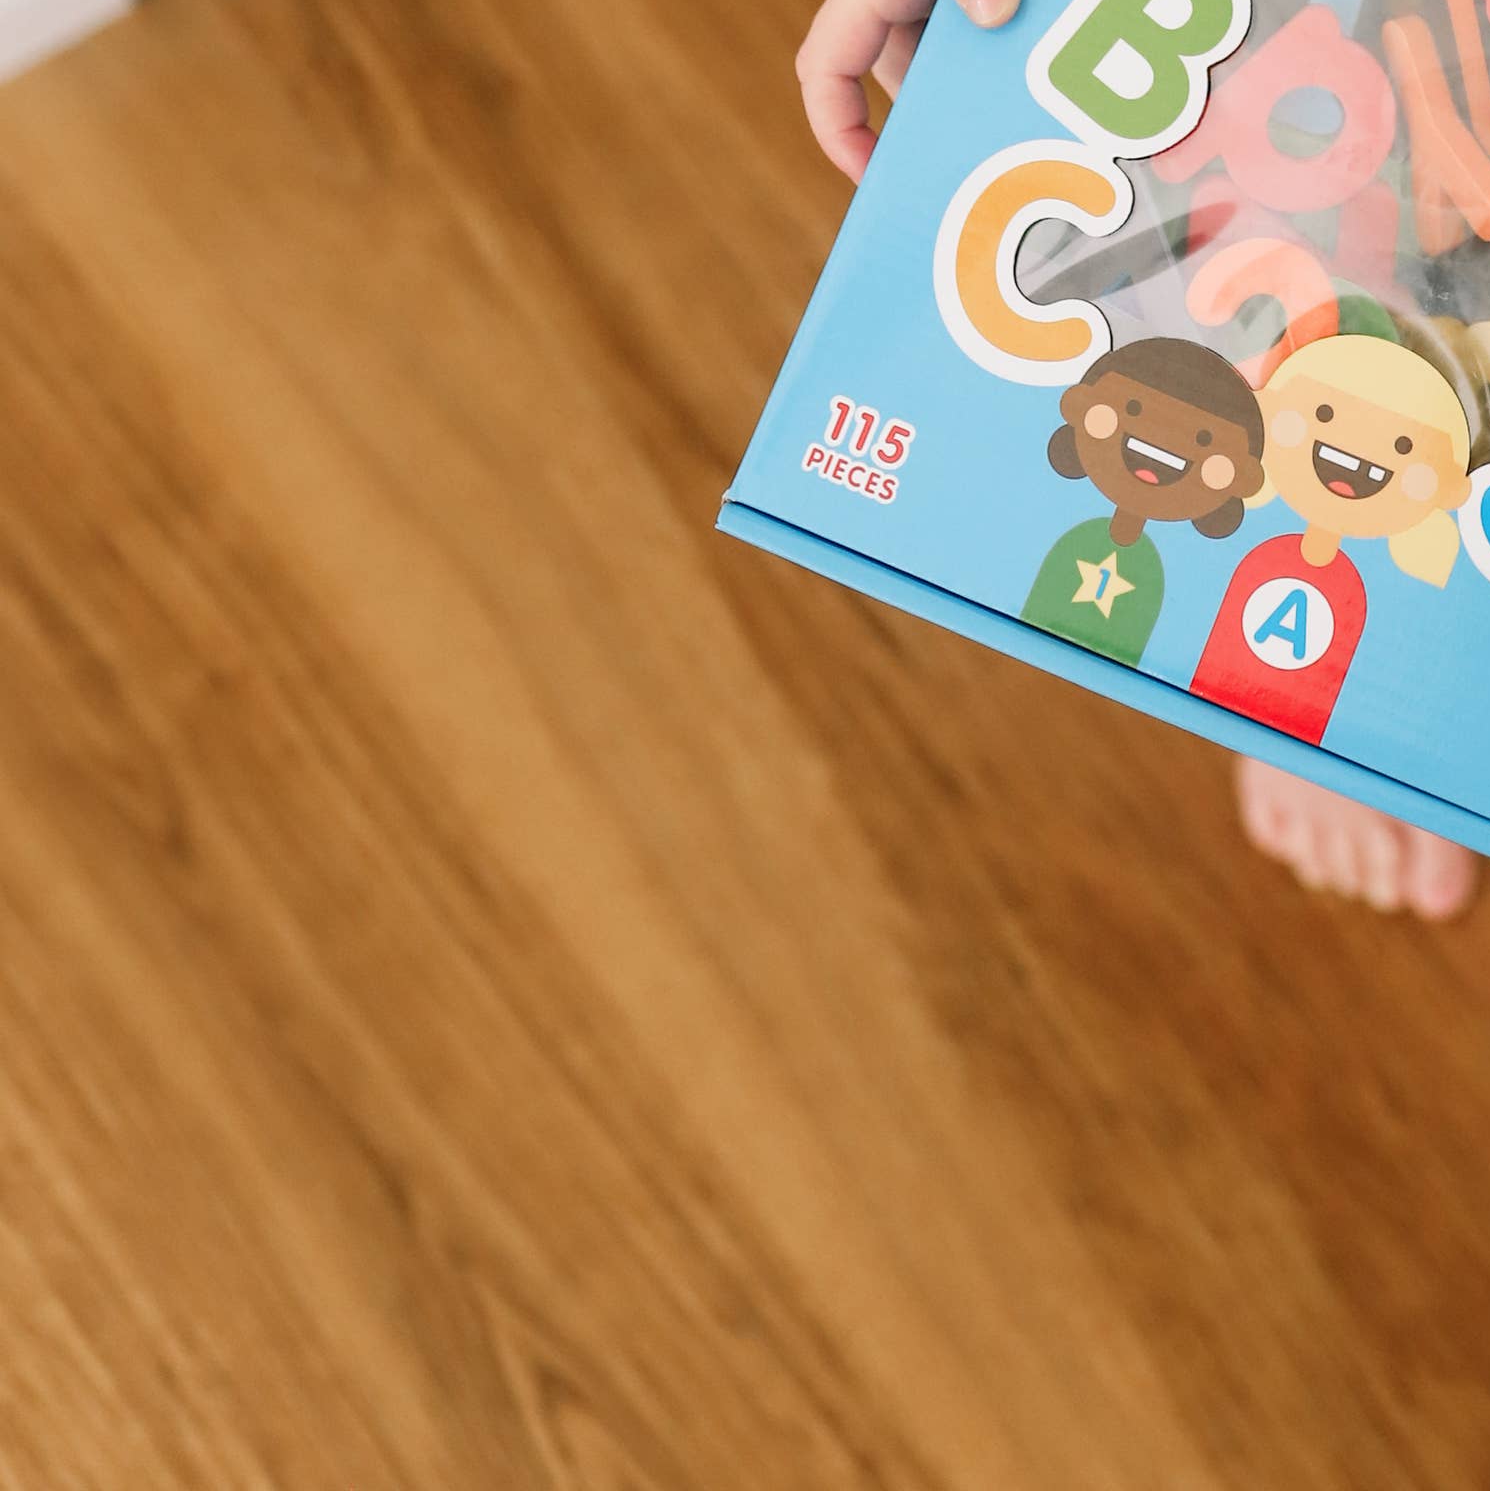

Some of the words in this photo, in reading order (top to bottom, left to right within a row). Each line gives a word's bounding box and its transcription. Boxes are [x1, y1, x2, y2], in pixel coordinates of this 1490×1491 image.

[955, 160, 1116, 361] C
[831, 401, 911, 464] 115
[806, 447, 896, 500] PIECES
[1095, 569, 1110, 600] 1
[1253, 588, 1308, 660] A
